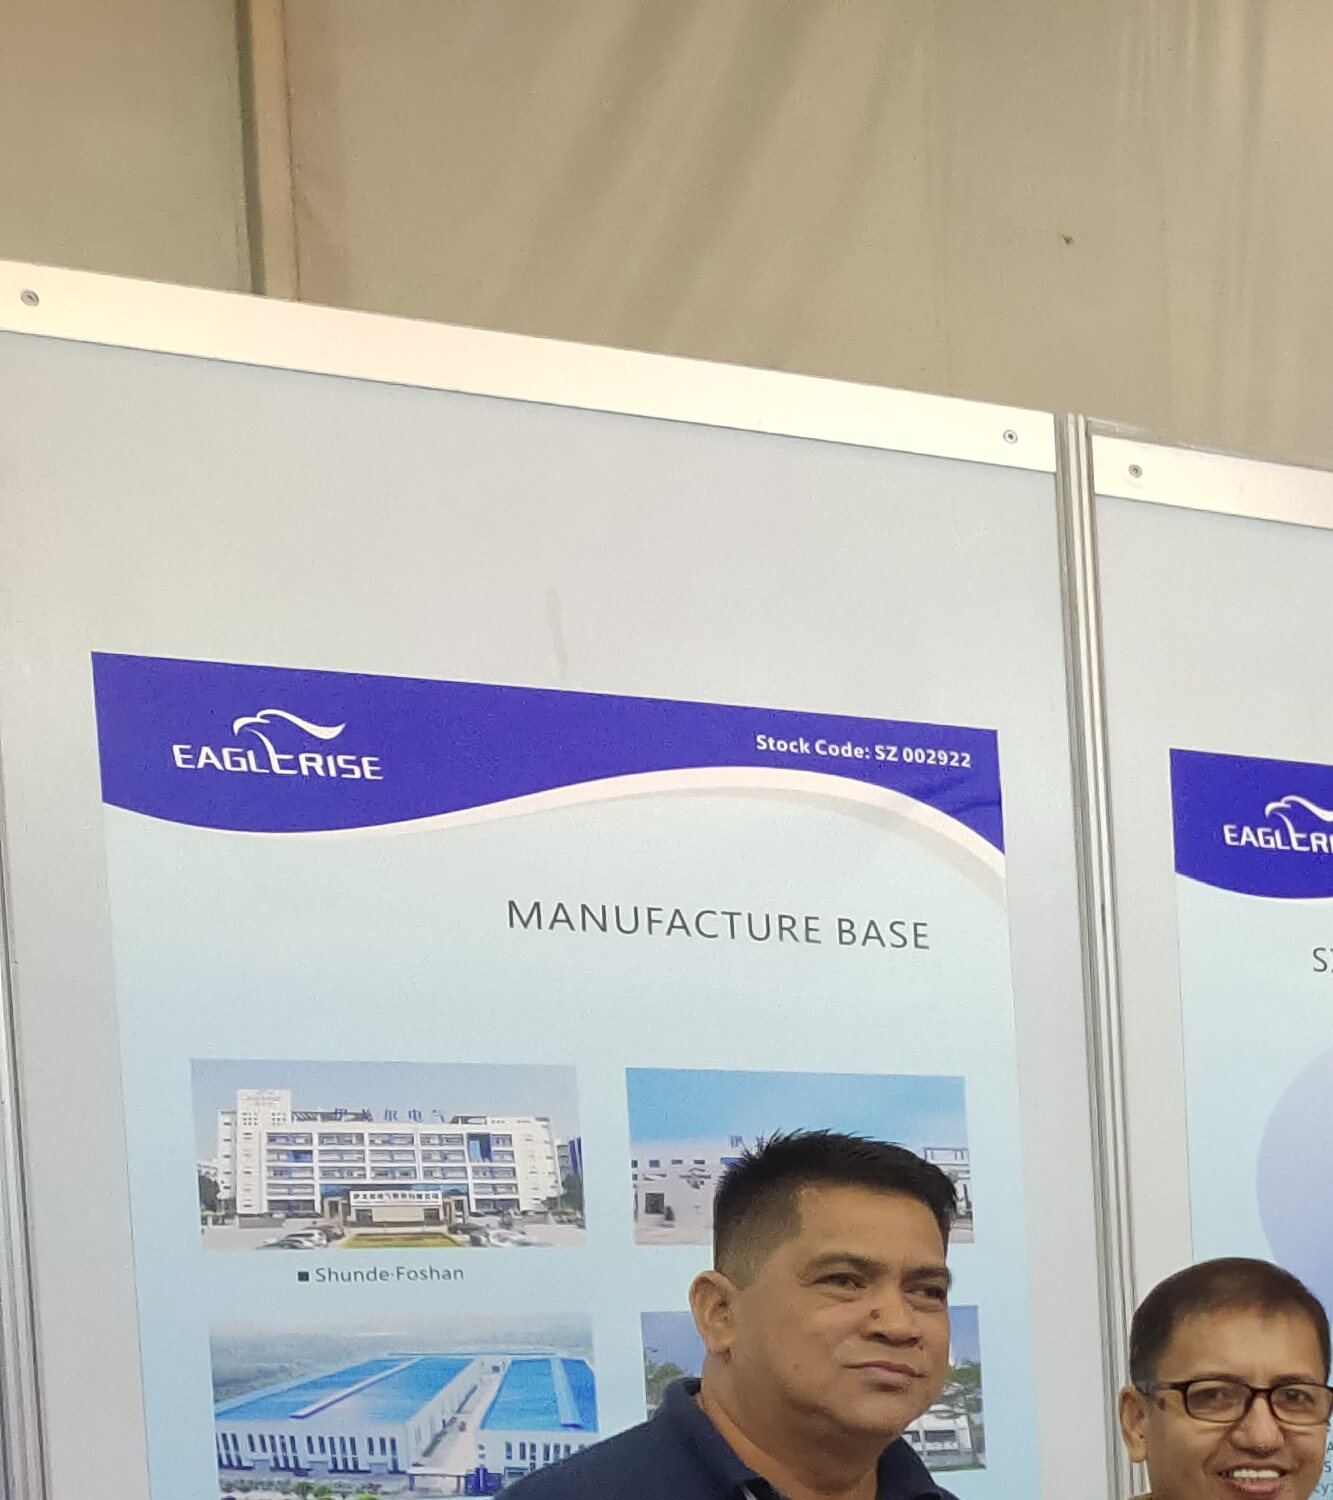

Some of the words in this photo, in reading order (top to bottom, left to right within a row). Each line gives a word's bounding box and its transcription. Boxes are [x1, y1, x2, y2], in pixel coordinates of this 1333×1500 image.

[172, 743, 384, 780] EAGLERISE
[756, 734, 810, 754] Stock
[815, 739, 871, 760] Code:
[875, 744, 899, 763] SZ
[902, 746, 972, 769] 002922
[506, 899, 823, 944] MANUFACTURE
[836, 917, 930, 950] BASE
